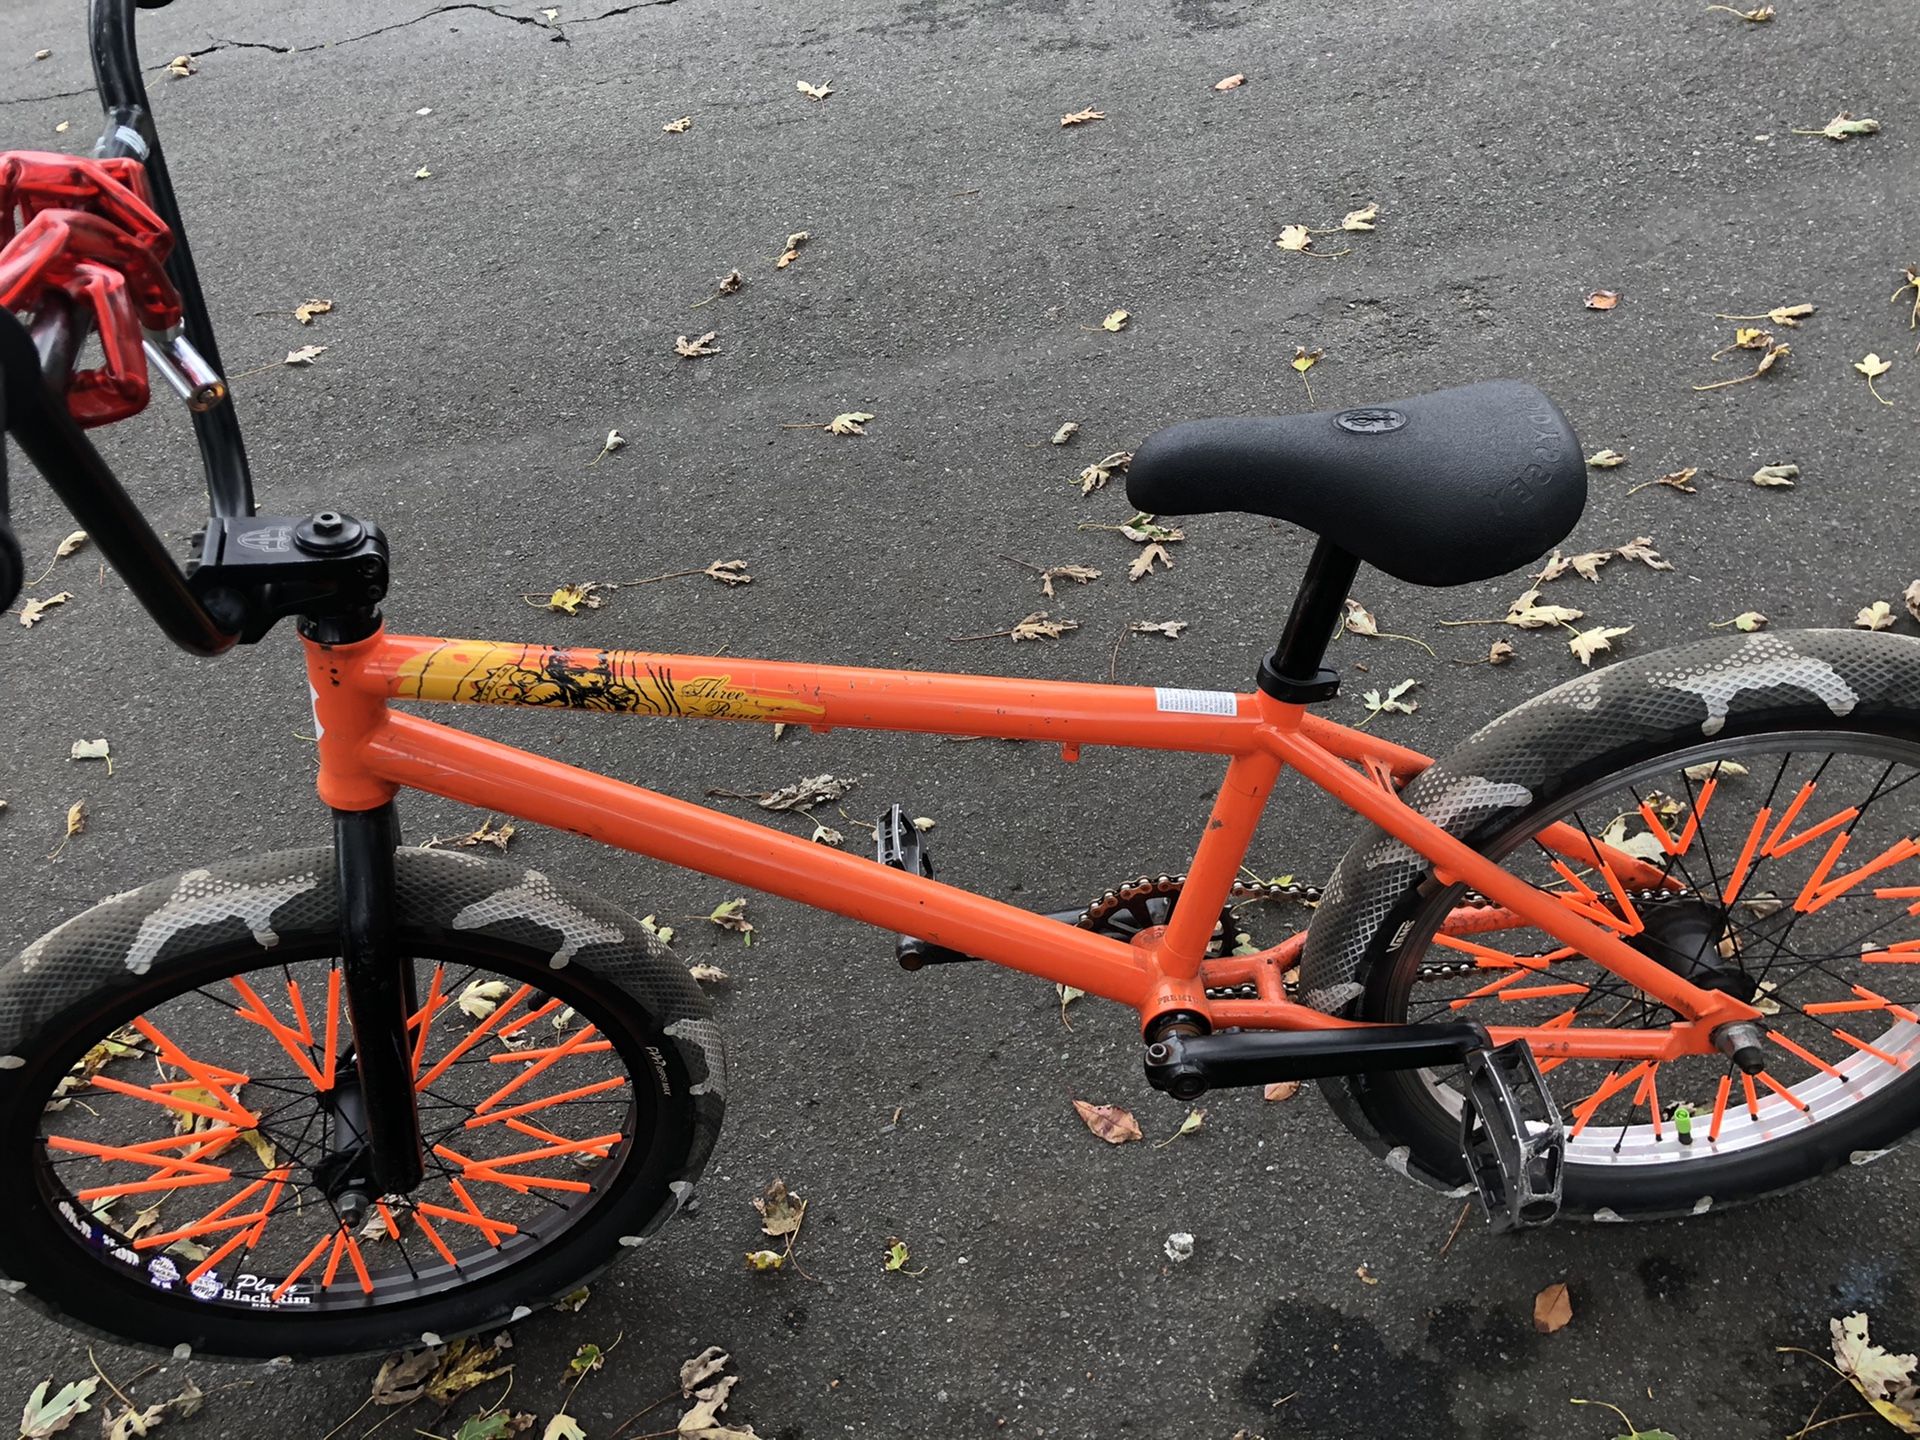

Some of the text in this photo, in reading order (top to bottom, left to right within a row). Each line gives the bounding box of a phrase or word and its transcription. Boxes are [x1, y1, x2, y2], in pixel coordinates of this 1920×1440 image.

[681, 676, 745, 702] Three
[236, 1273, 299, 1293] Plan
[222, 1288, 311, 1305] Black Rim
